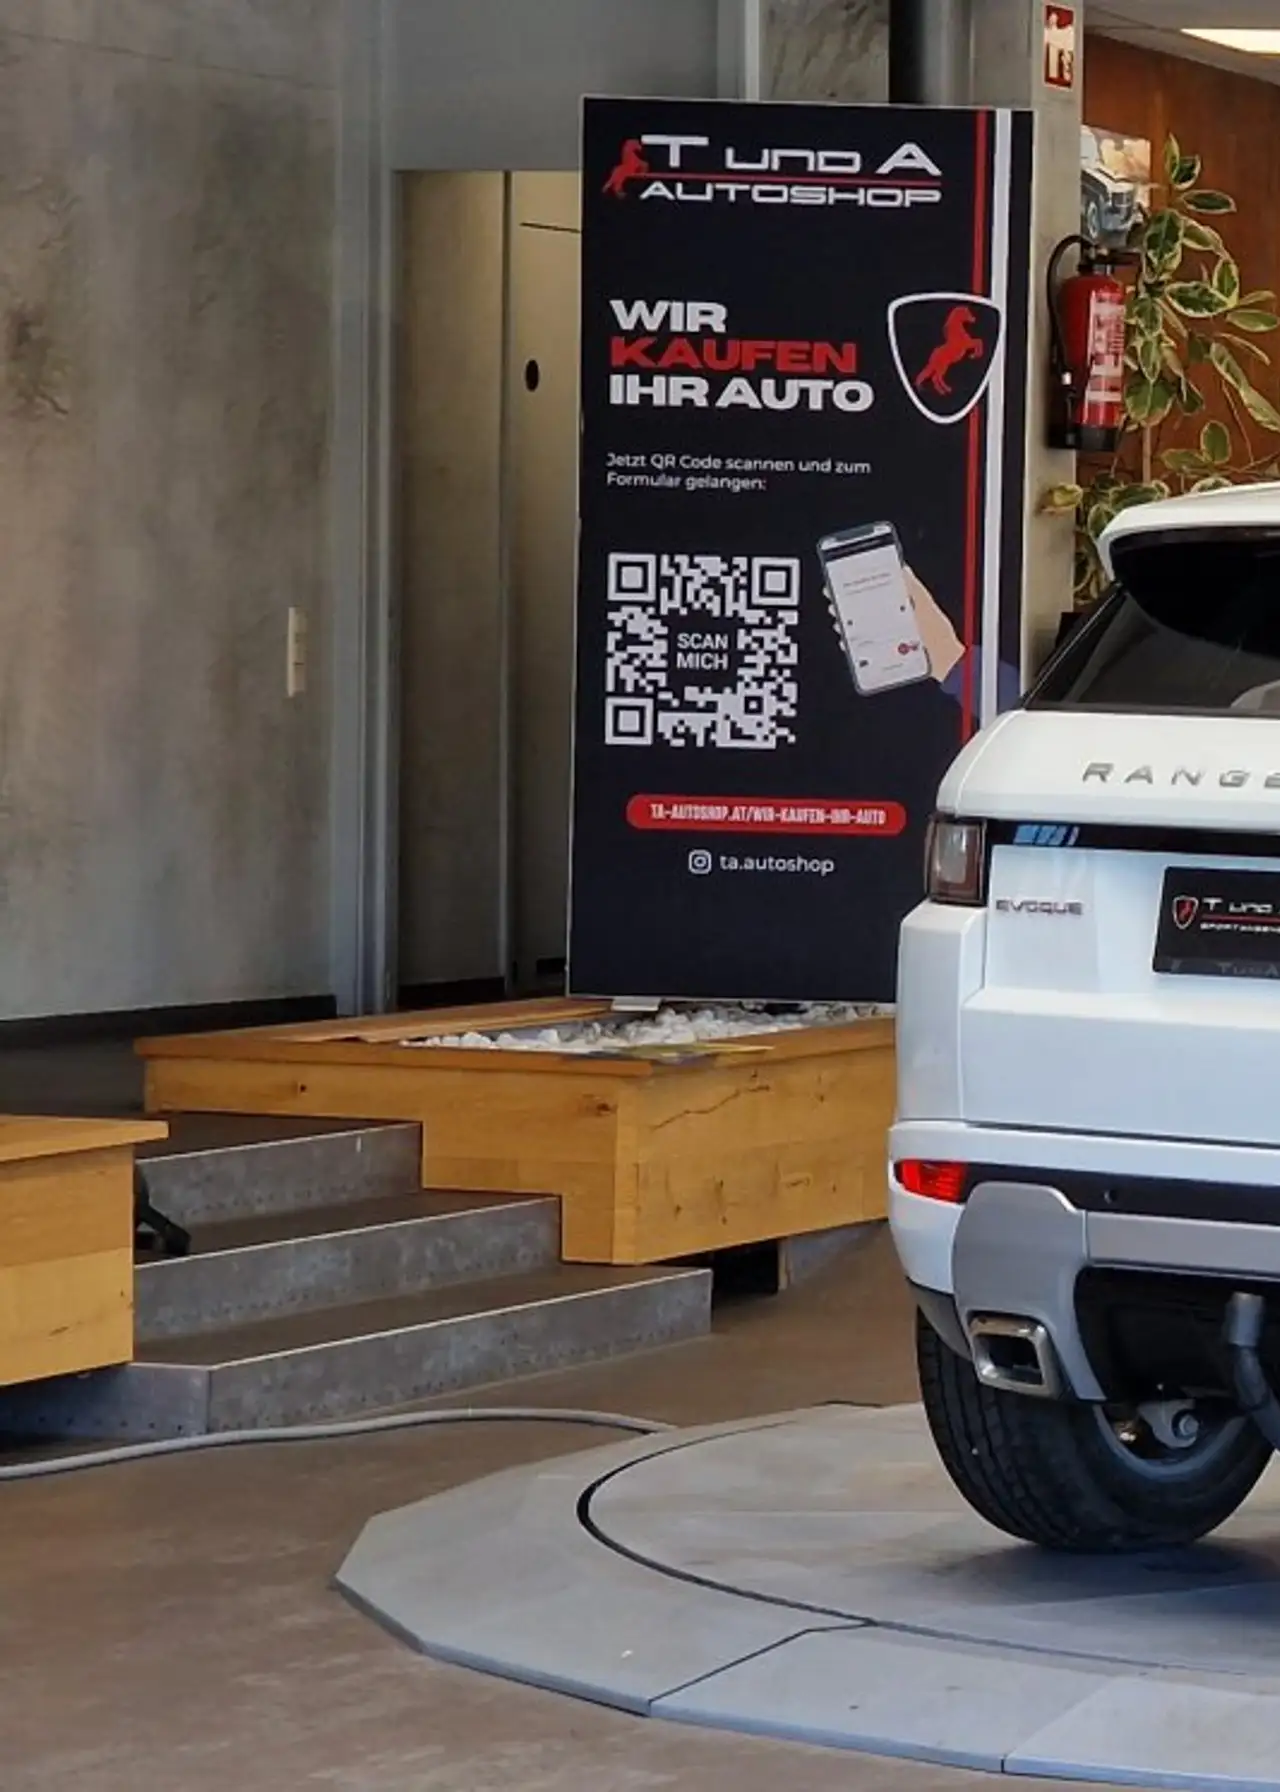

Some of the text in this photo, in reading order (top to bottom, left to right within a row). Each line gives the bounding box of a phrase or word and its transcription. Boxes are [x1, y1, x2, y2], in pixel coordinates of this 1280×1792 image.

[640, 133, 709, 169] T
[874, 141, 943, 177] A
[639, 180, 943, 208] AUTOSHOP
[609, 299, 728, 333] WIR
[610, 335, 858, 374] KAUFEN
[609, 373, 875, 413] IHR AUTO
[605, 452, 872, 474] Jetzt QR Code scannen und zum
[606, 471, 768, 493] Formular gelangen:
[676, 631, 729, 650] SCAN
[676, 651, 729, 671] MICH
[719, 854, 835, 877] ta.autoshop
[995, 898, 1083, 916] EVOQUE
[1202, 897, 1223, 912] T
